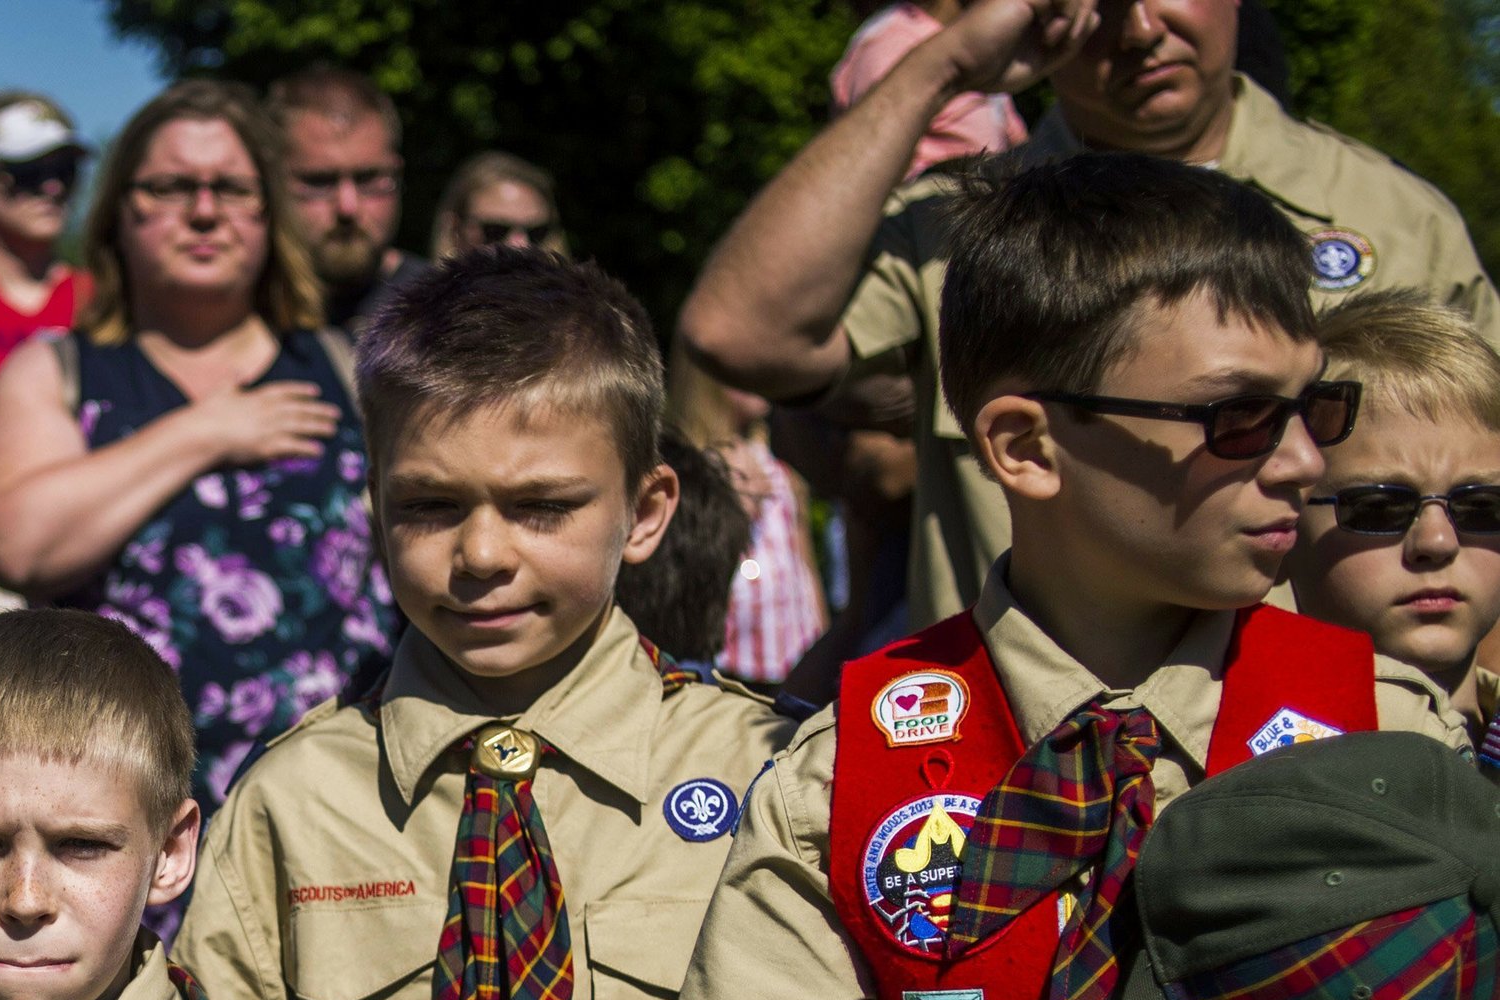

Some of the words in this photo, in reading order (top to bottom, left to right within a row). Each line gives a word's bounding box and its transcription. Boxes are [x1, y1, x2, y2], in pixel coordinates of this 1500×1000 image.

[894, 714, 949, 730] FOOD
[895, 723, 950, 739] DRIVE
[1256, 723, 1283, 751] BLUE
[1282, 717, 1294, 729] &
[909, 799, 933, 816] 2013
[944, 797, 958, 808] BE
[960, 799, 967, 808] A
[876, 810, 909, 843] WOODS
[867, 843, 884, 864] AND
[356, 880, 416, 899] AMERICA
[865, 866, 878, 901] WATER
[885, 876, 902, 889] BE
[907, 873, 916, 885] A
